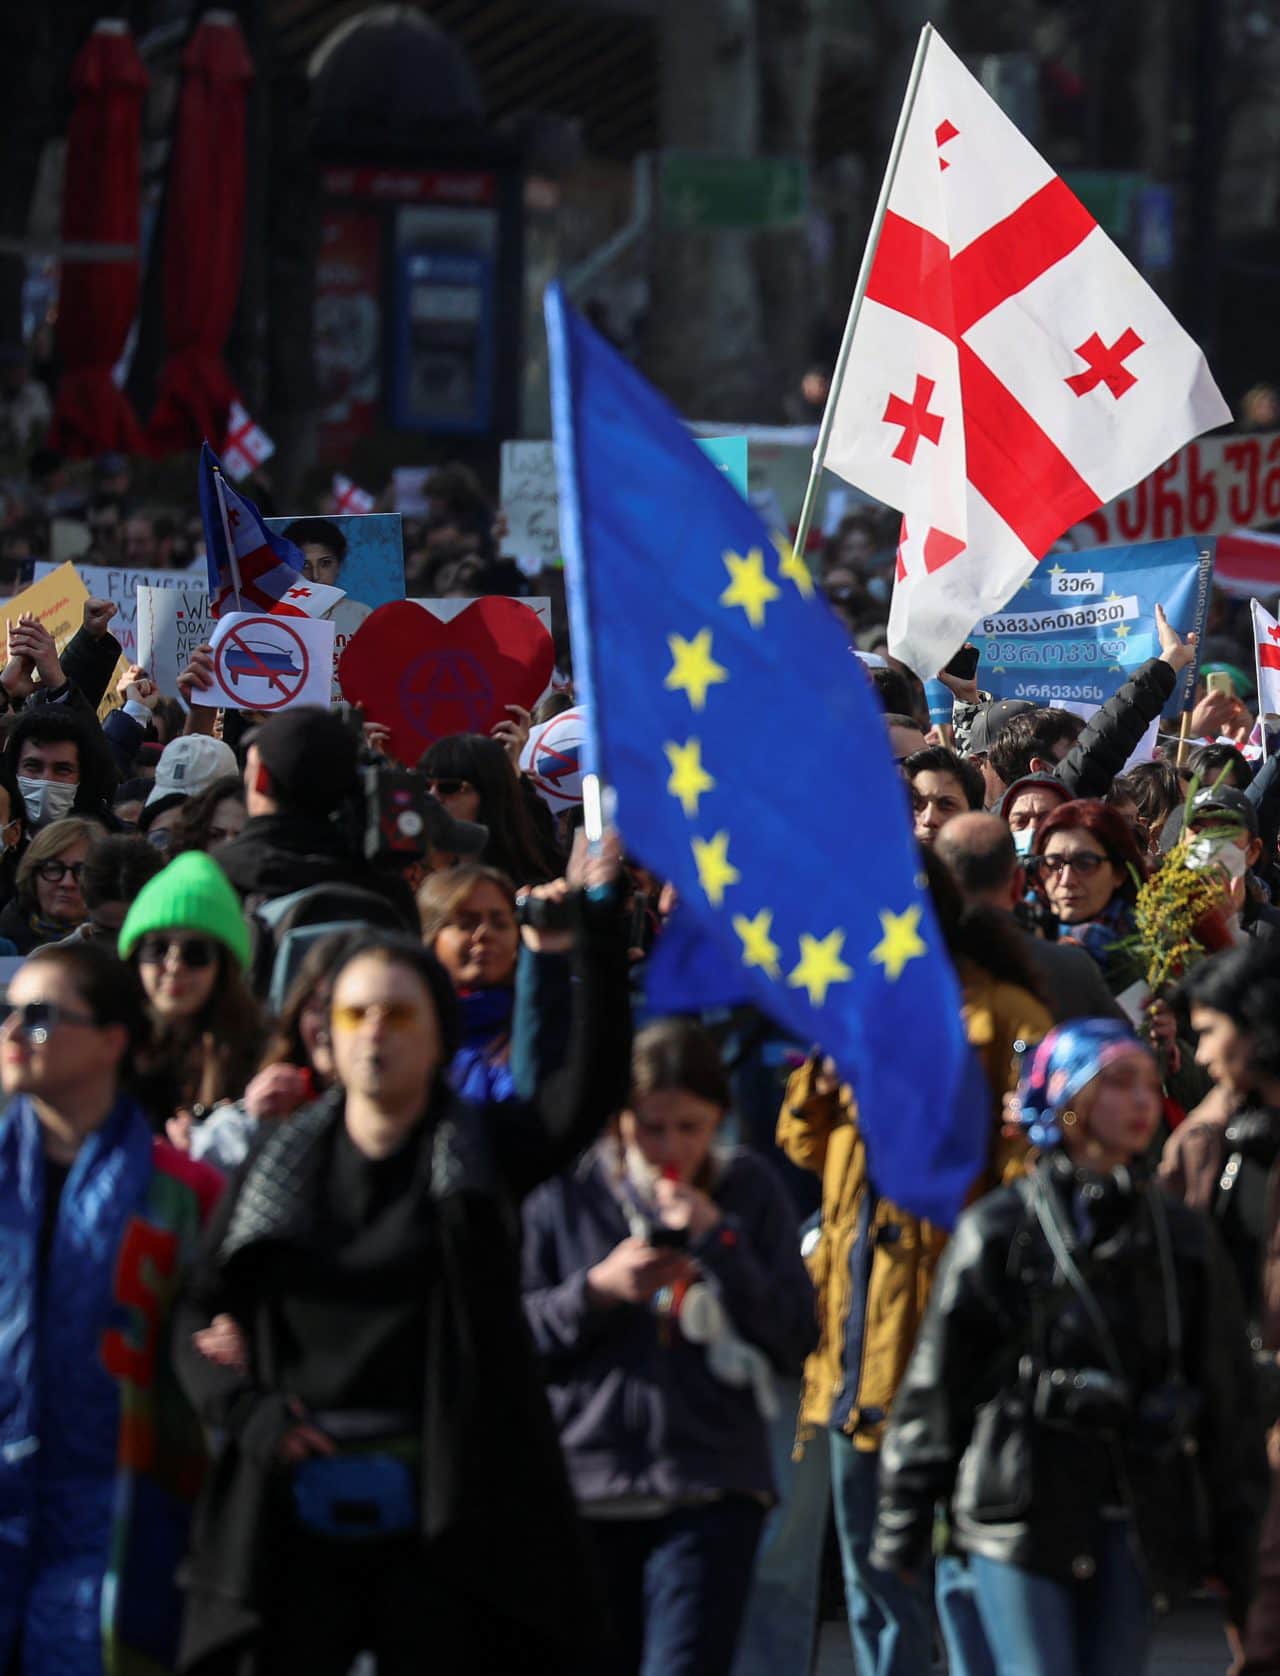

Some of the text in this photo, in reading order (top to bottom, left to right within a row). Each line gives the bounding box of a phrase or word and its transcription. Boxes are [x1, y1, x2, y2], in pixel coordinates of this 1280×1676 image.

[1058, 578, 1095, 593] ვერ
[983, 603, 1125, 634] წაგვართმევთ
[176, 620, 218, 635] DON'
[986, 640, 1127, 664] ევროპულ
[1014, 683, 1104, 699] არჩევანს
